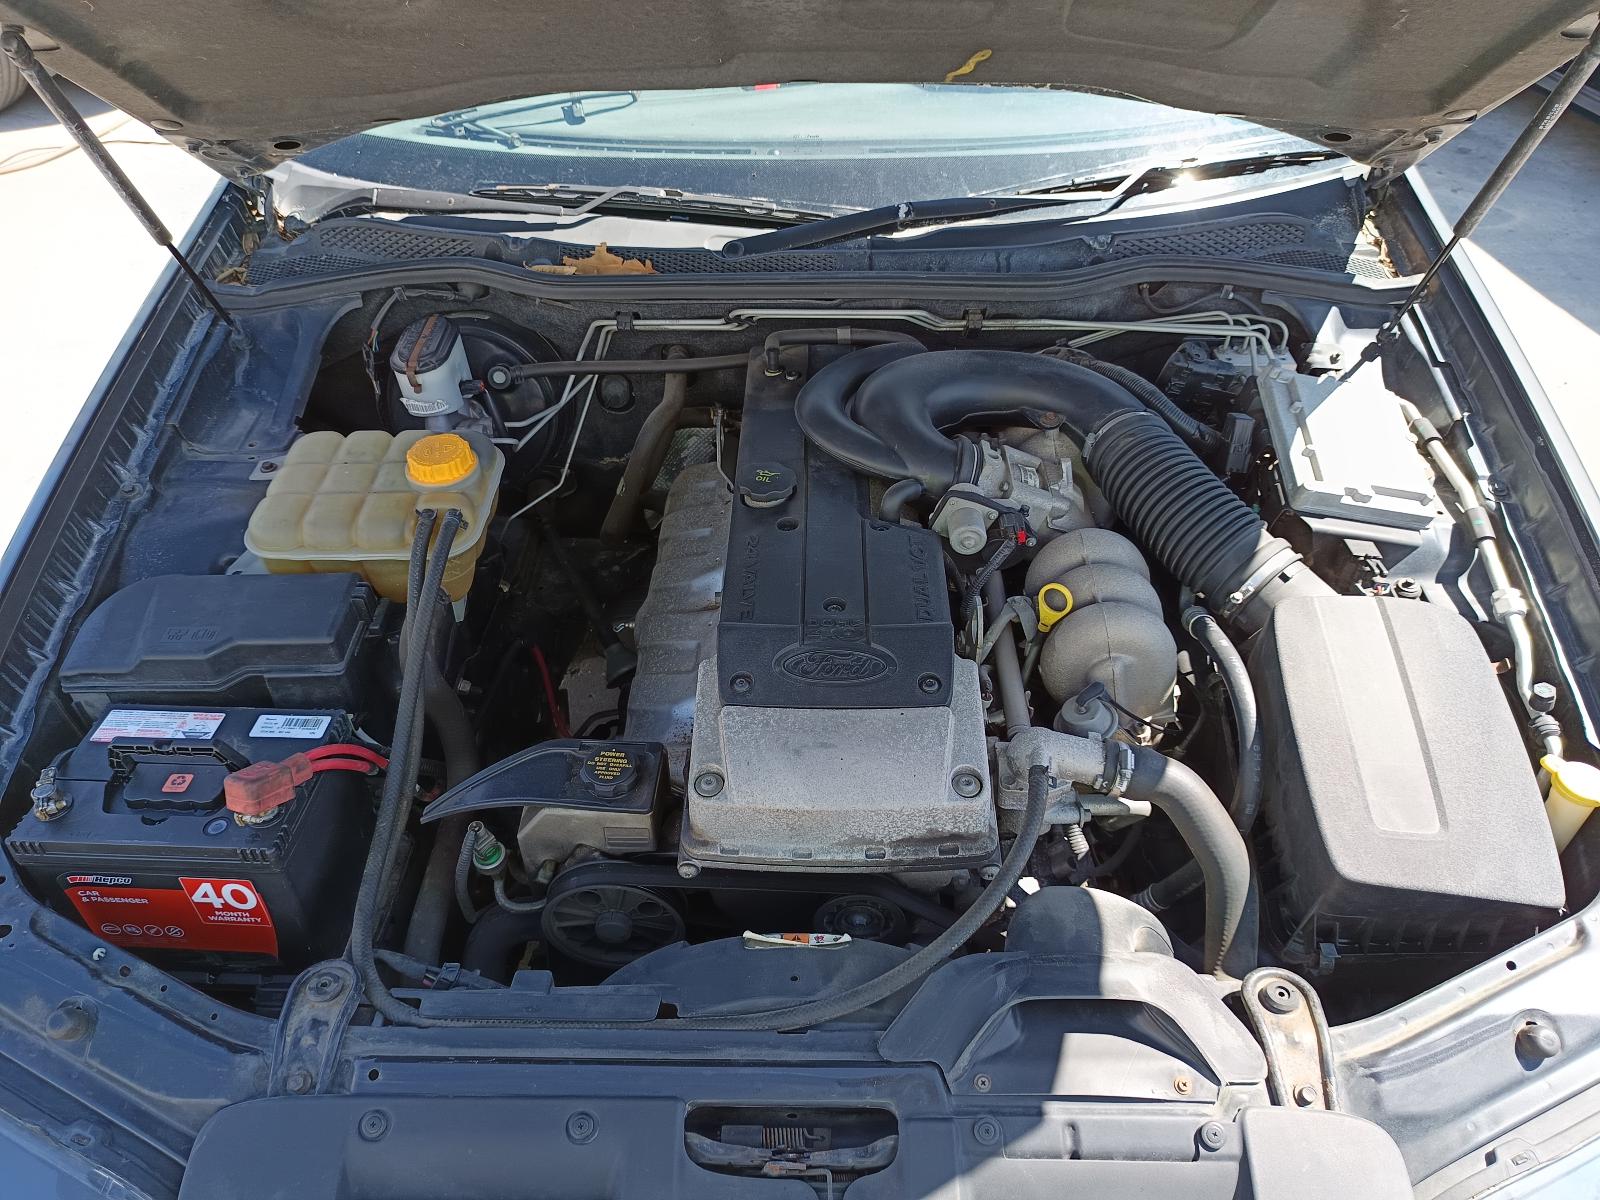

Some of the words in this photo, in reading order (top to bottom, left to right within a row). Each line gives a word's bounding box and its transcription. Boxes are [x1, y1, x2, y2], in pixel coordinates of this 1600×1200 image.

[755, 475, 772, 483] OIL
[740, 561, 760, 621] VALVE
[803, 653, 871, 677] Ford
[90, 896, 149, 904] PASSENGER
[192, 882, 258, 910] 40
